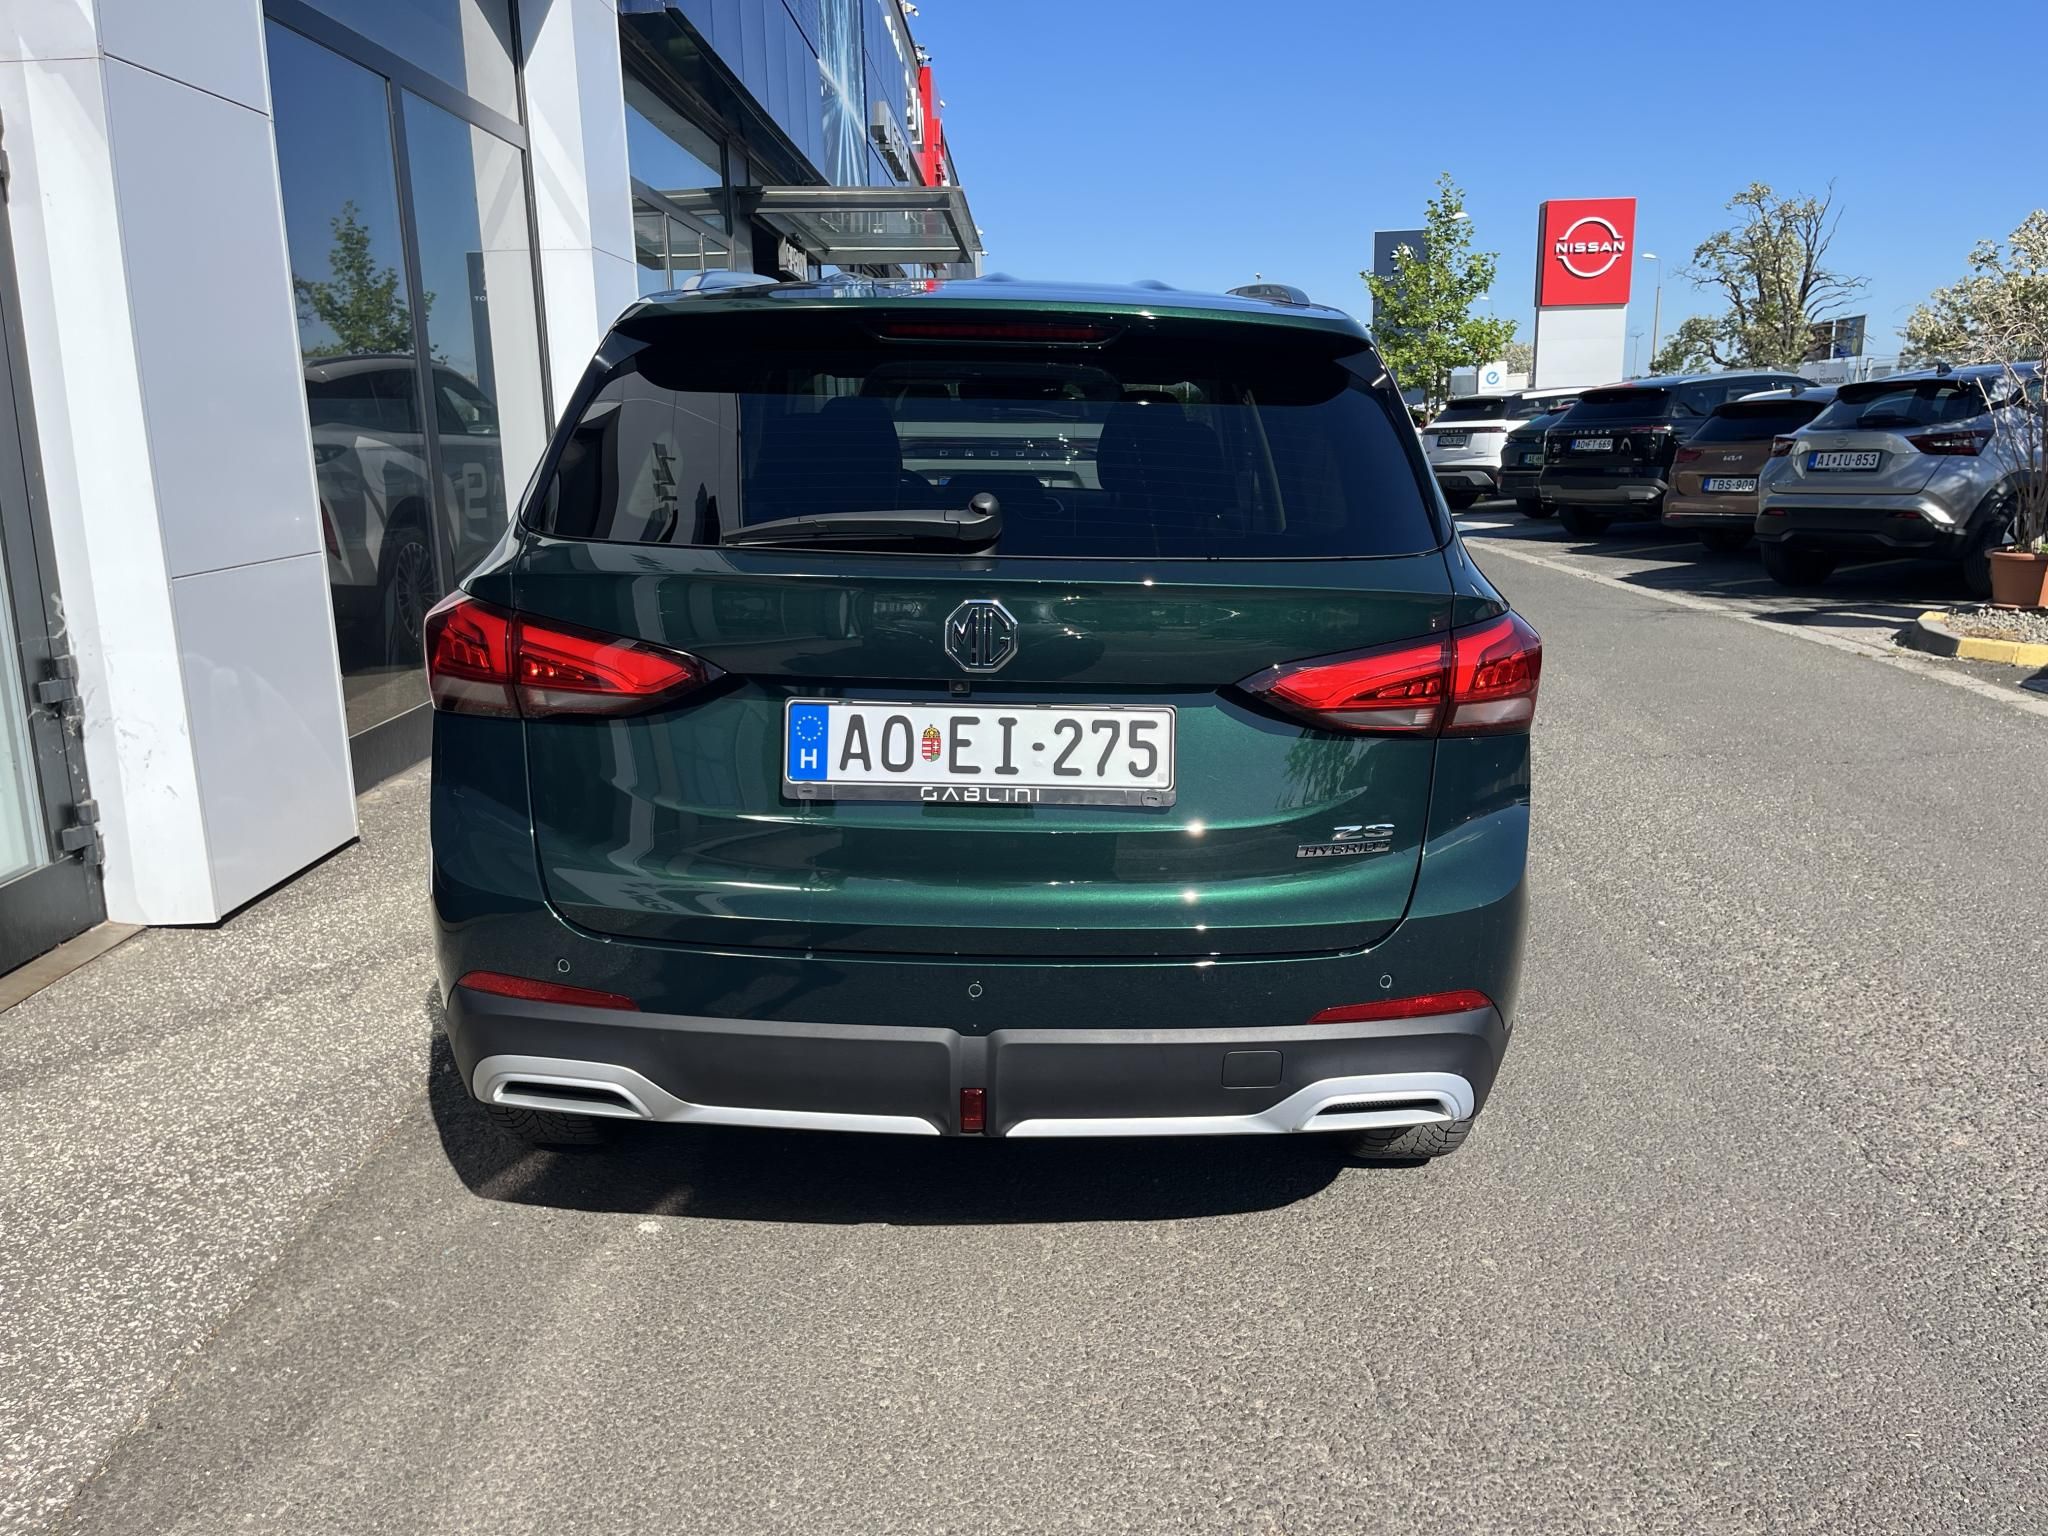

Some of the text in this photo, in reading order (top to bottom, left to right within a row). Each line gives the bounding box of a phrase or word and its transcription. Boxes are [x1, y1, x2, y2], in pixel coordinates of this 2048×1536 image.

[1555, 241, 1625, 253] NISSAN
[1712, 479, 1755, 490] TBS-908
[952, 607, 1011, 666] MG
[800, 748, 817, 769] H
[920, 786, 1040, 802] GABLINI
[1332, 823, 1395, 841] ZS
